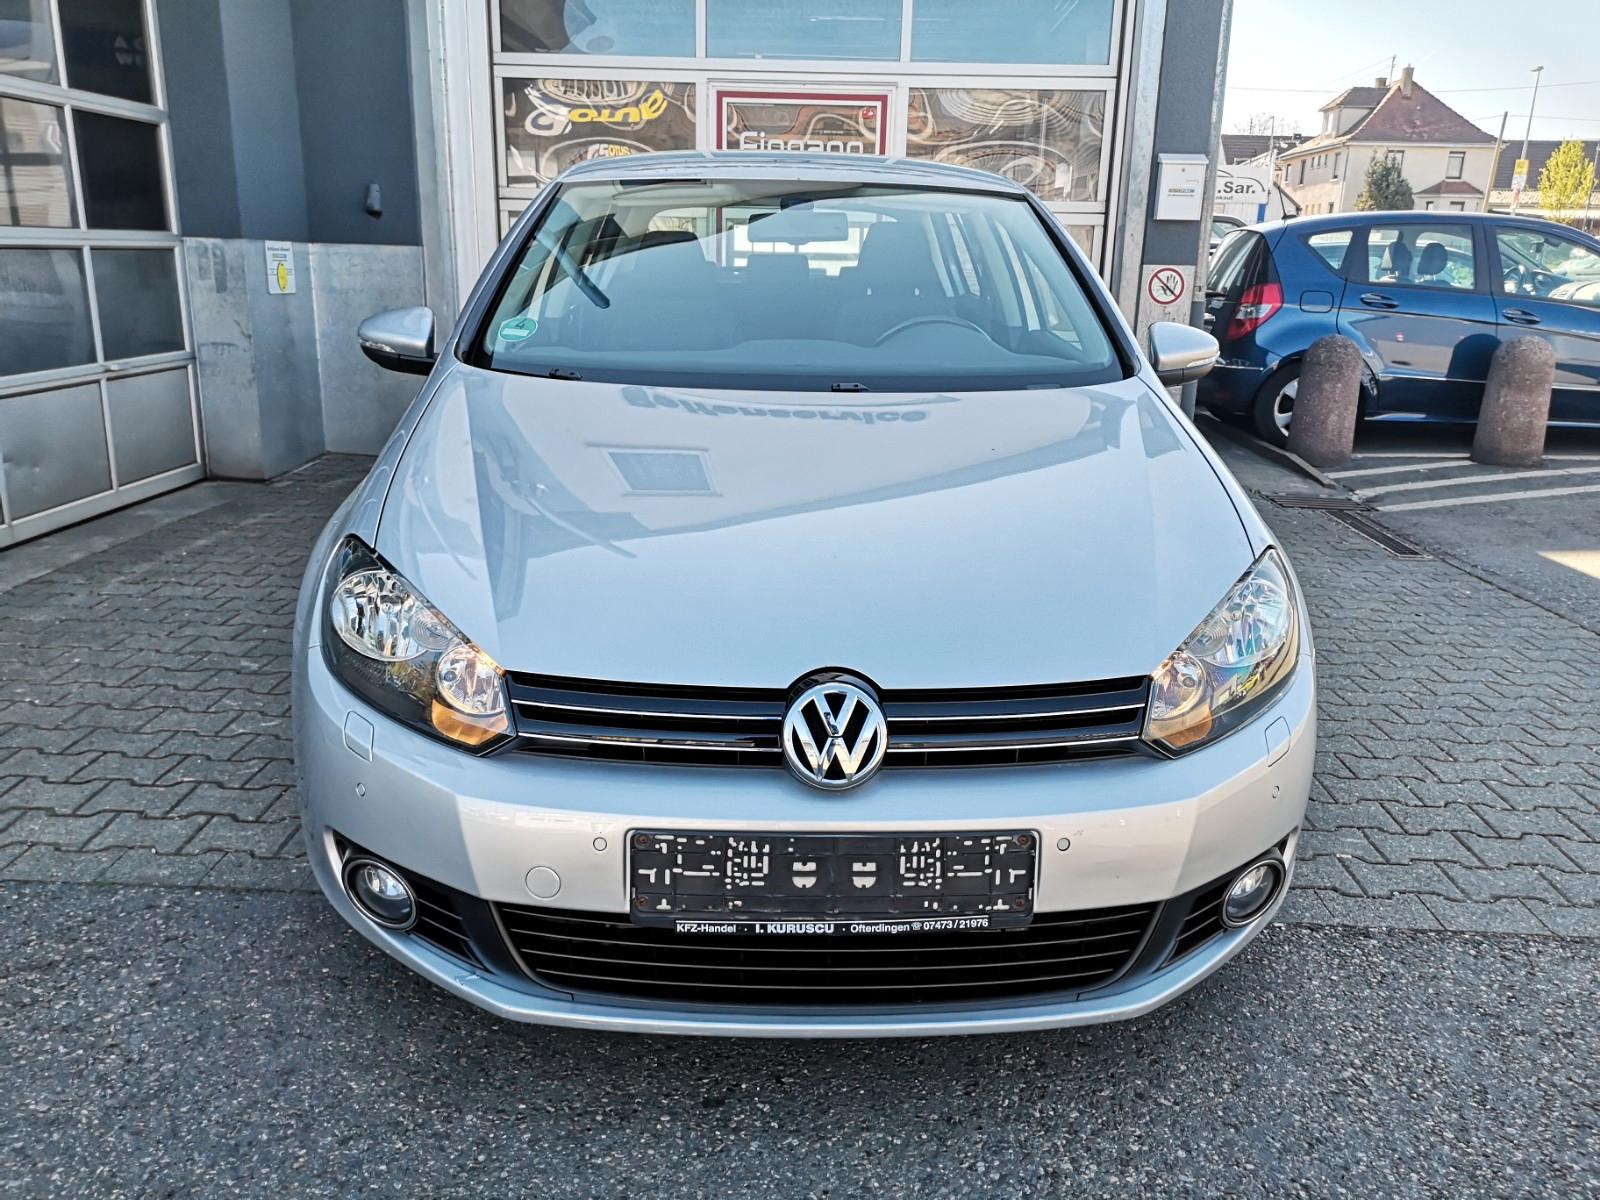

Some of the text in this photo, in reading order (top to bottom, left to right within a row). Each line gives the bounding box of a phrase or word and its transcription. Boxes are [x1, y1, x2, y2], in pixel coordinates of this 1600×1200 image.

[514, 318, 528, 330] 4
[676, 923, 737, 933] KFZ-Handel
[767, 923, 835, 934] KURUSCU
[850, 923, 910, 934] Ofterdingen
